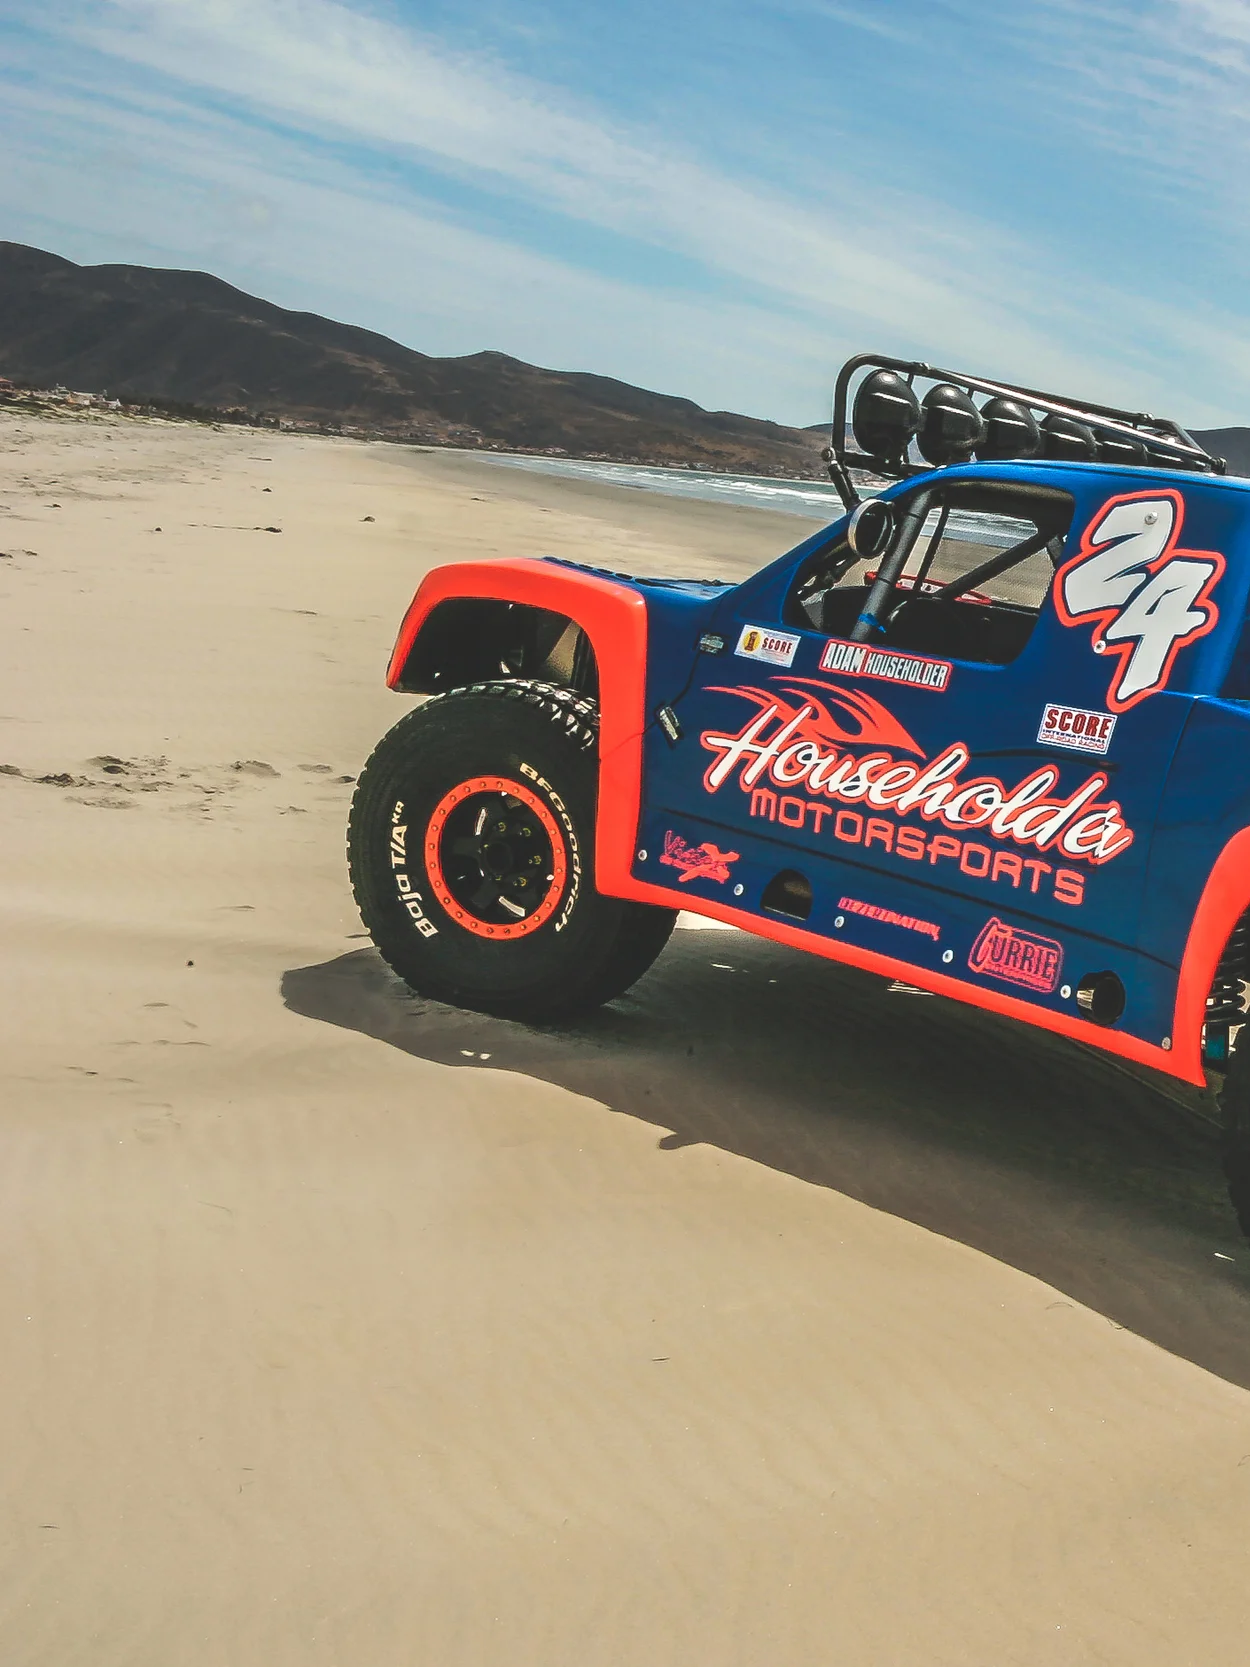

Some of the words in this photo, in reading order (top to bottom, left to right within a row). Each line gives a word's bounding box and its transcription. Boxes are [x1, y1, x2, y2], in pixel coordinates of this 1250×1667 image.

[761, 637, 793, 654] SCORE
[1062, 498, 1217, 703] 24
[822, 642, 868, 674] ADAM
[863, 652, 948, 688] HOUSEHOLDER
[1045, 708, 1112, 739] SCORE
[706, 703, 1132, 860] Householder
[519, 762, 582, 932] BFGoodrich
[750, 787, 1086, 906] MOTORSPORTS
[396, 874, 440, 938] Baja
